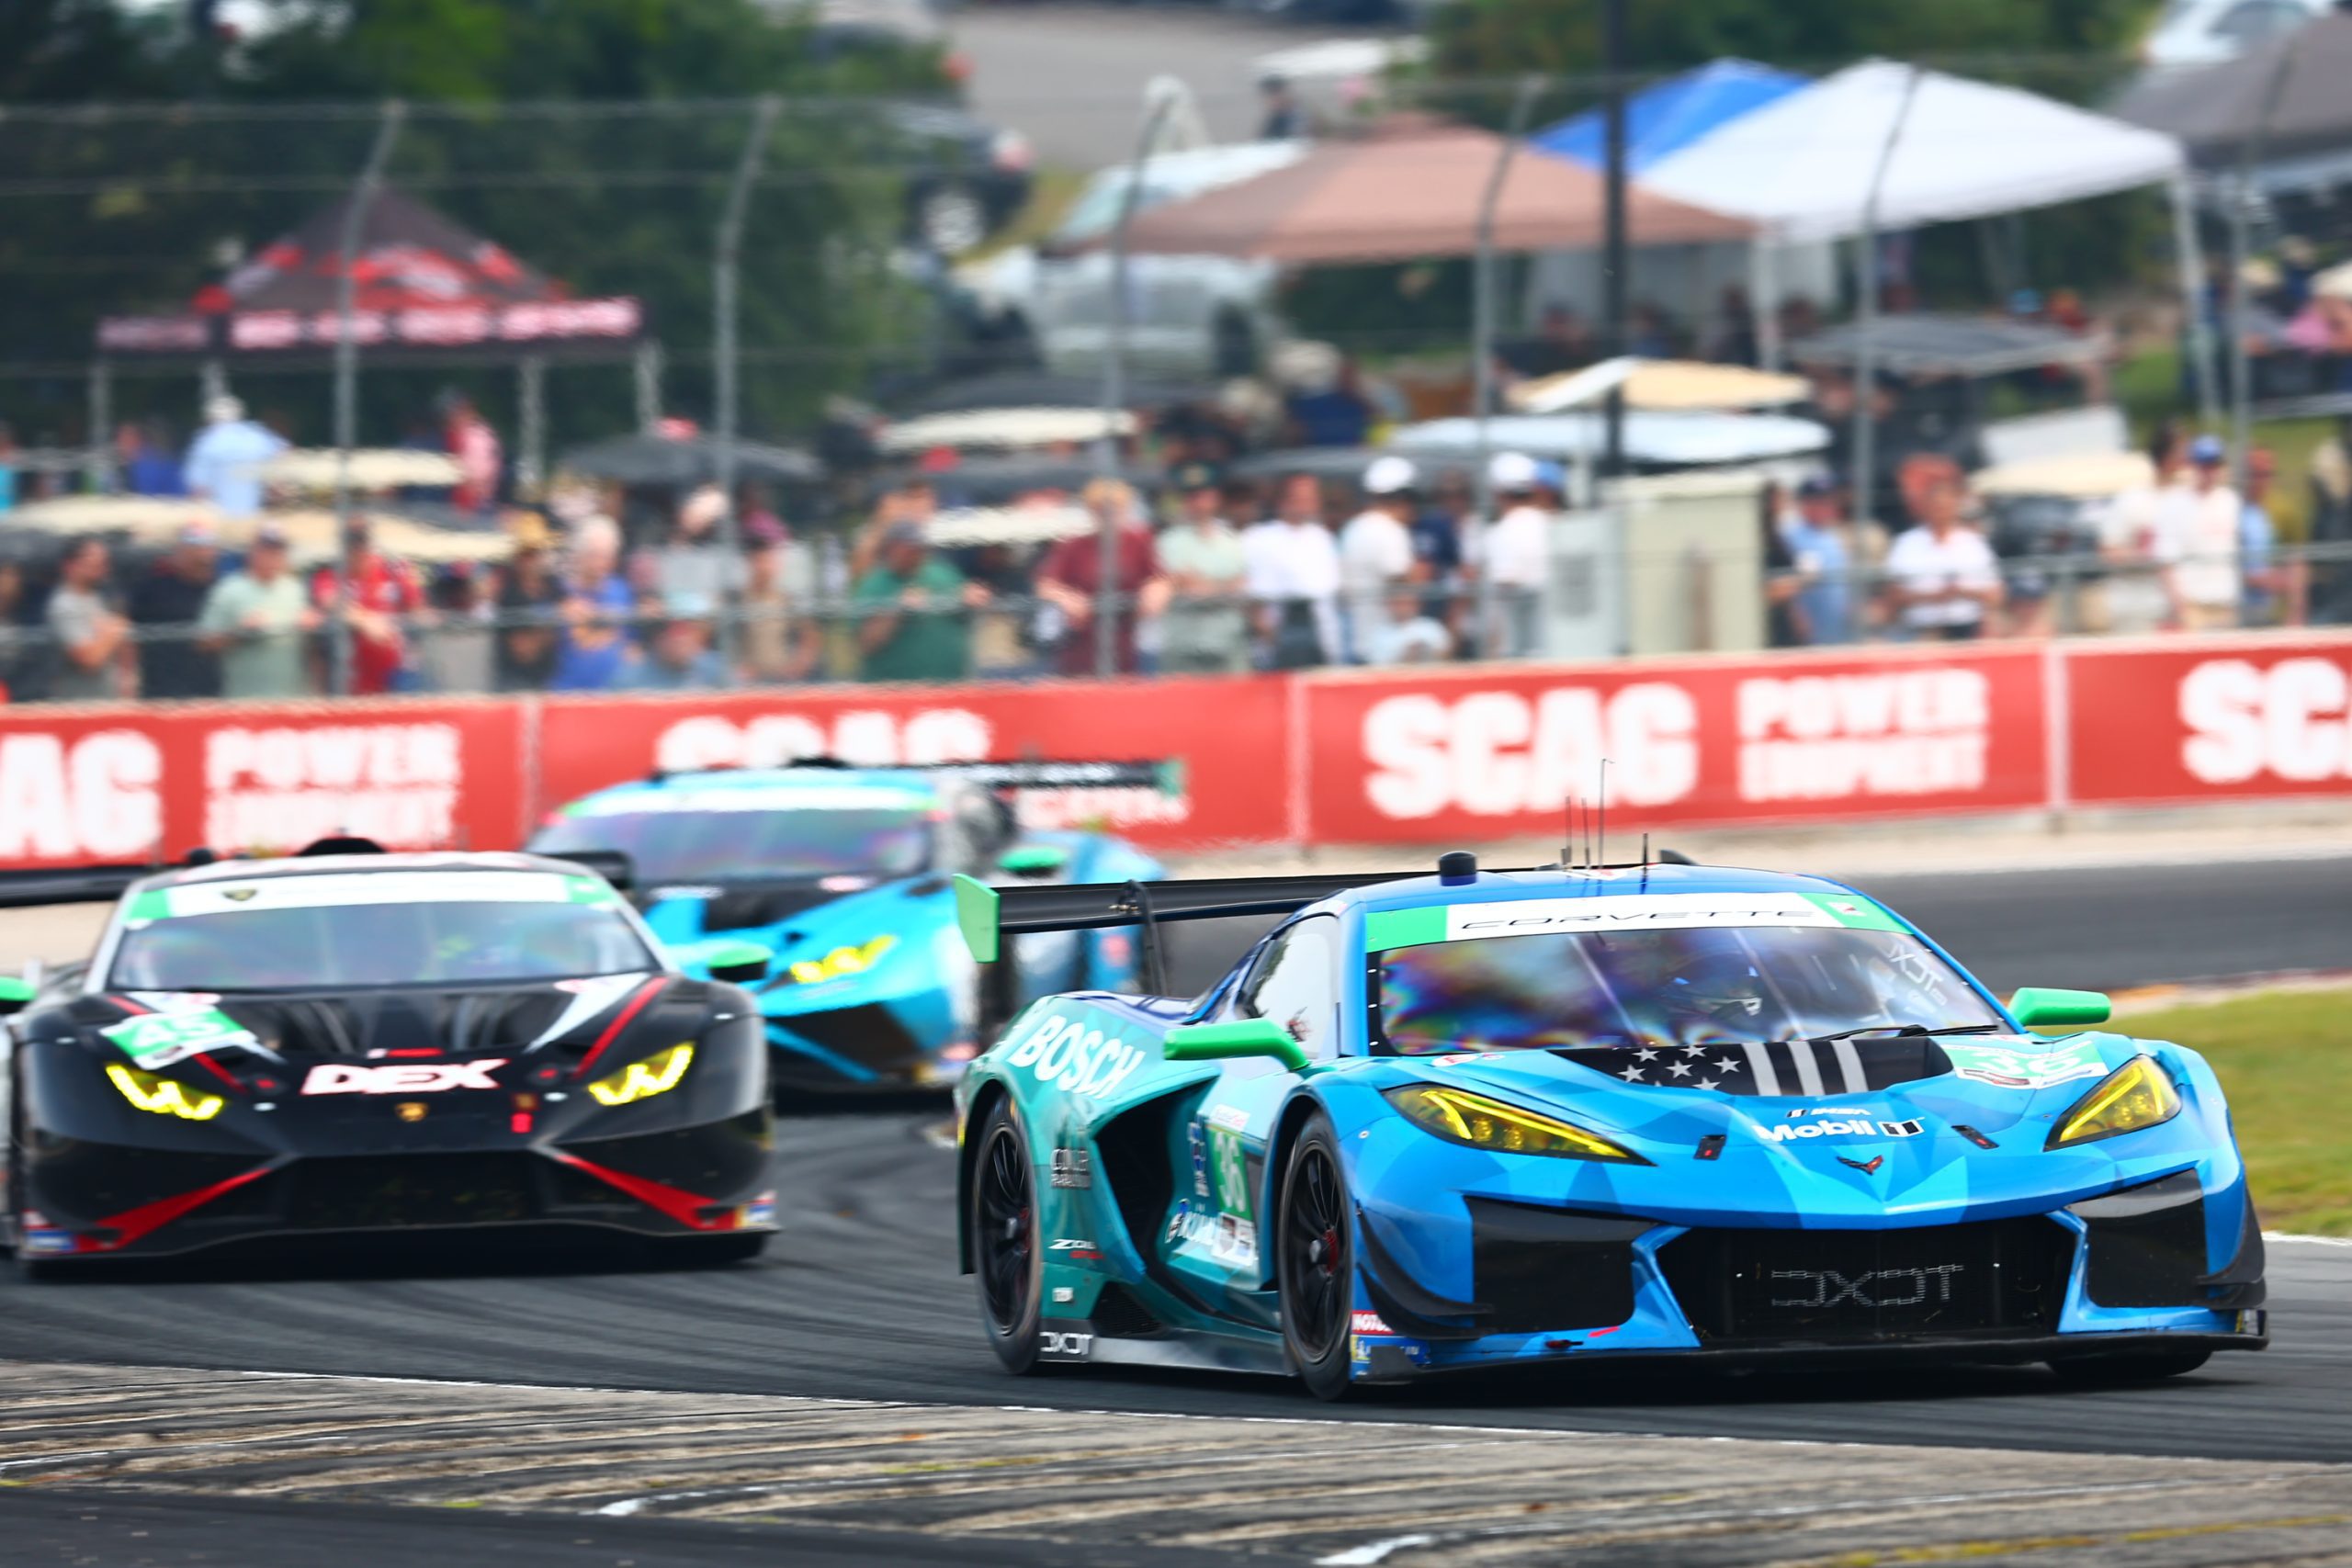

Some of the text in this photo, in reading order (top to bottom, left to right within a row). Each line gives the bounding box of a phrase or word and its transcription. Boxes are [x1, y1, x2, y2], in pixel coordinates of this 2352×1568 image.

[1736, 668, 1989, 739] POWER
[2178, 658, 2352, 784] SC
[206, 723, 461, 789] POWER
[1363, 682, 1700, 819] SCAG
[1461, 909, 1815, 930] CORVETTE
[300, 1057, 509, 1095] DEX
[1006, 1014, 1147, 1100] BOSCH
[1971, 1051, 2082, 1076] 36
[1752, 1119, 1877, 1142] Mobil
[1215, 1131, 1247, 1213] 36
